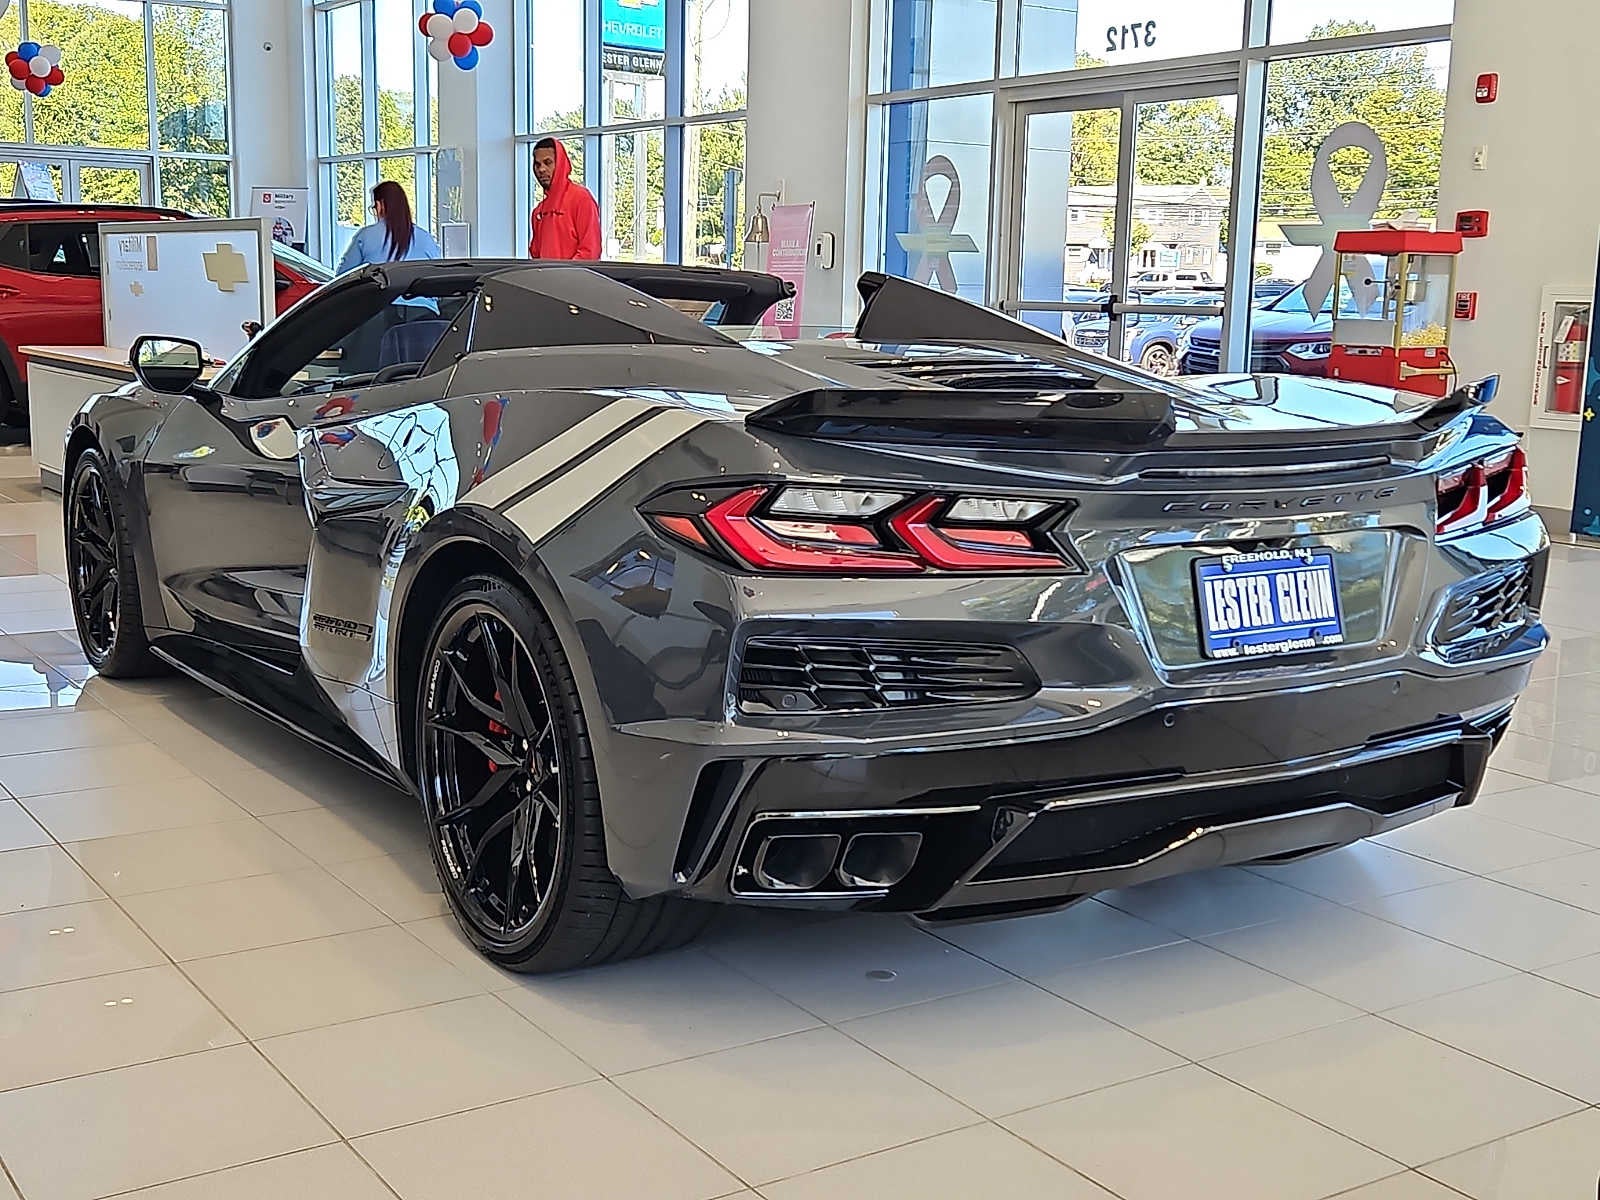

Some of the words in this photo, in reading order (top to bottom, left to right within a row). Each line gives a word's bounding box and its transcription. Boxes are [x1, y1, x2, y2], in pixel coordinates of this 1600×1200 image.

[602, 20, 662, 39] HEVROLET
[602, 52, 630, 67] ESTER
[1162, 487, 1398, 512] CORVETTE
[1222, 550, 1293, 565] FREEHOLD,
[1295, 548, 1312, 560] NJ
[1203, 575, 1274, 632] LESTER
[1275, 569, 1336, 623] GLENN
[1243, 637, 1316, 656] lesterglenn
[426, 659, 441, 710] CORVETTE
